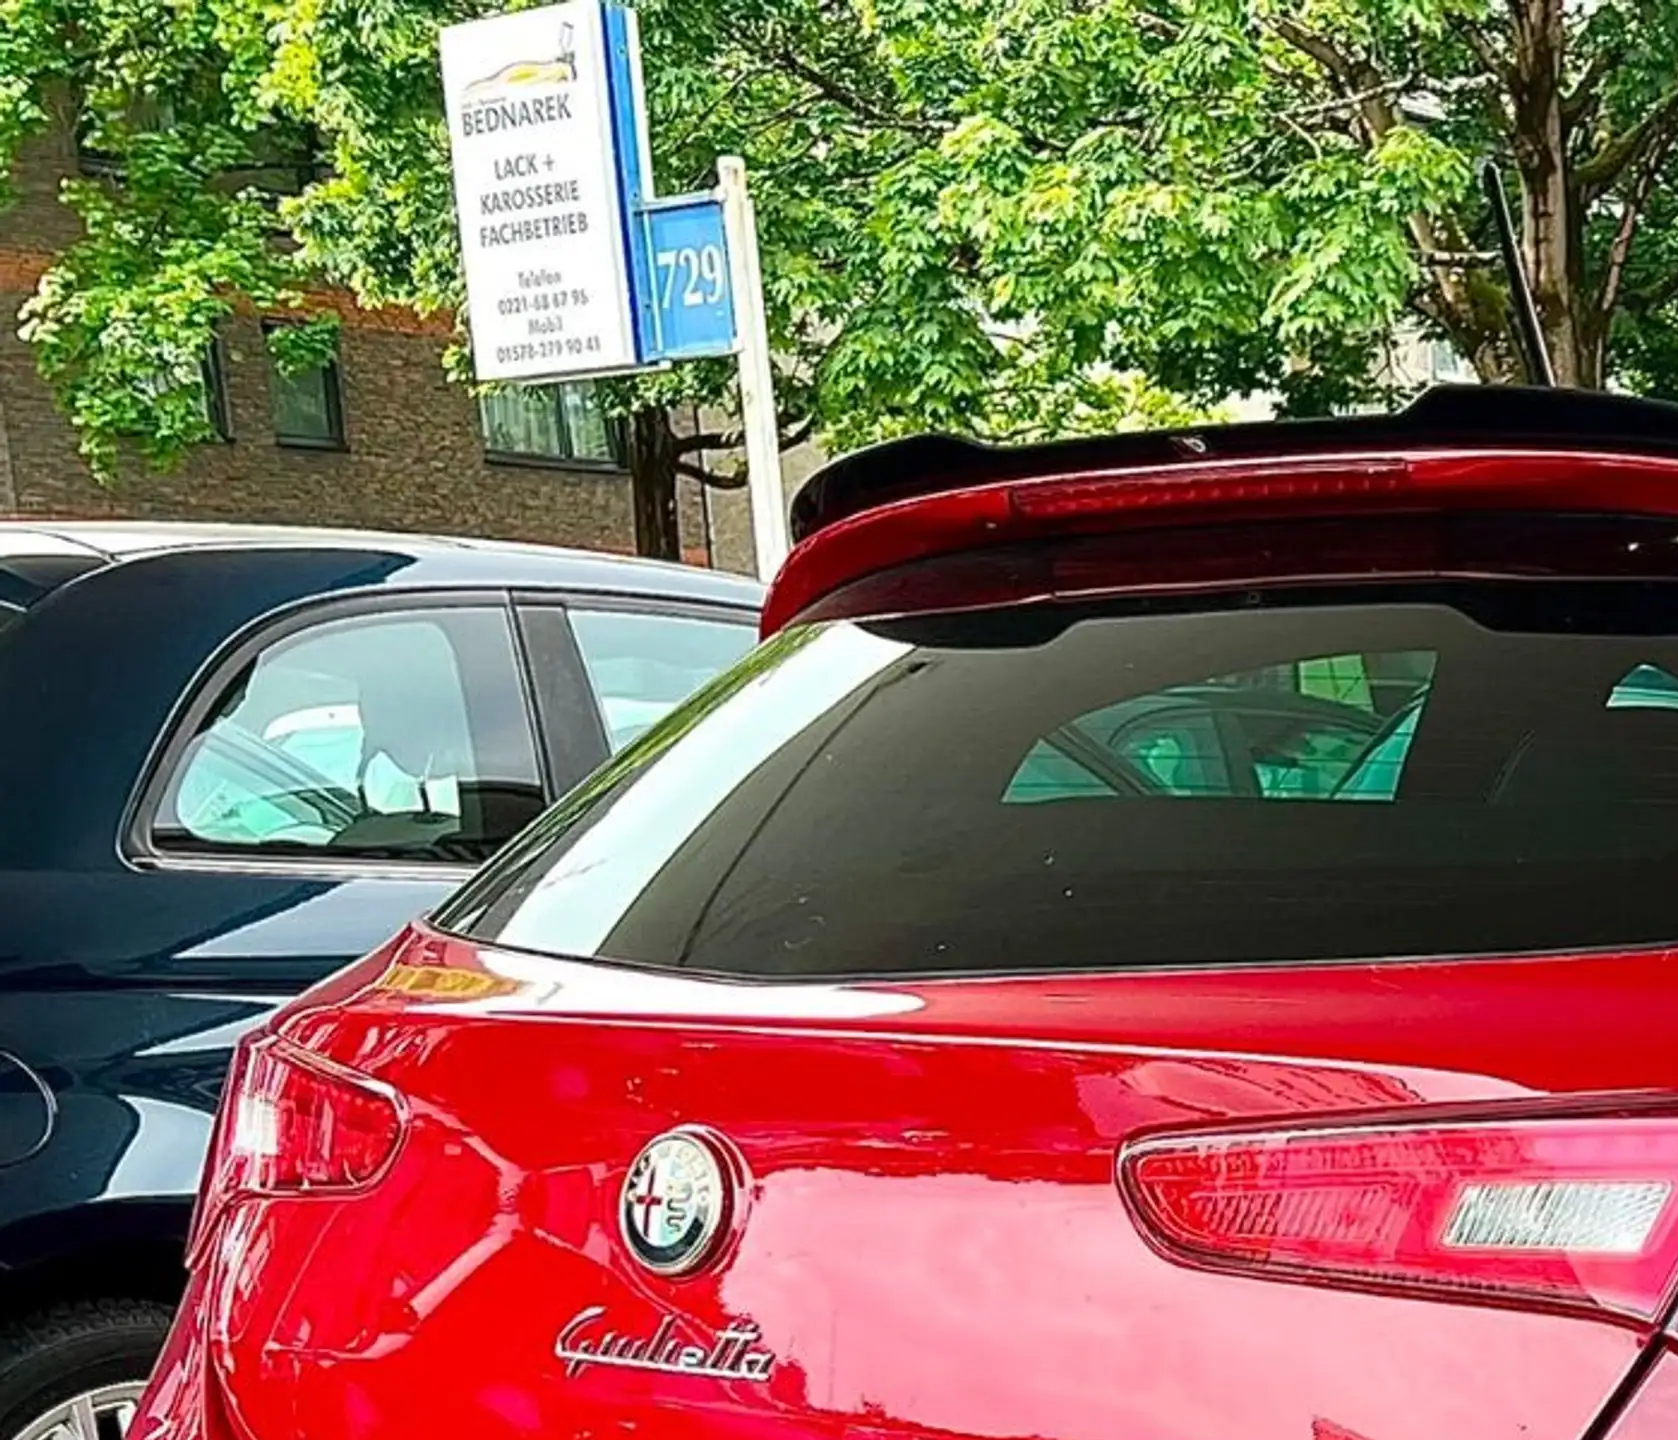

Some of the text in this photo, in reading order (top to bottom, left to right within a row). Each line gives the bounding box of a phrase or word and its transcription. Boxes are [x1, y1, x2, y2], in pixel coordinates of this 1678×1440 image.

[462, 93, 572, 138] BEDNAREK
[494, 153, 555, 181] LACK +
[480, 179, 580, 215] KAROSSERIE
[480, 212, 589, 248] FACHBETRIEB
[518, 269, 561, 289] Telefon
[656, 245, 724, 309] 729
[555, 1306, 776, 1383] Giulietta
